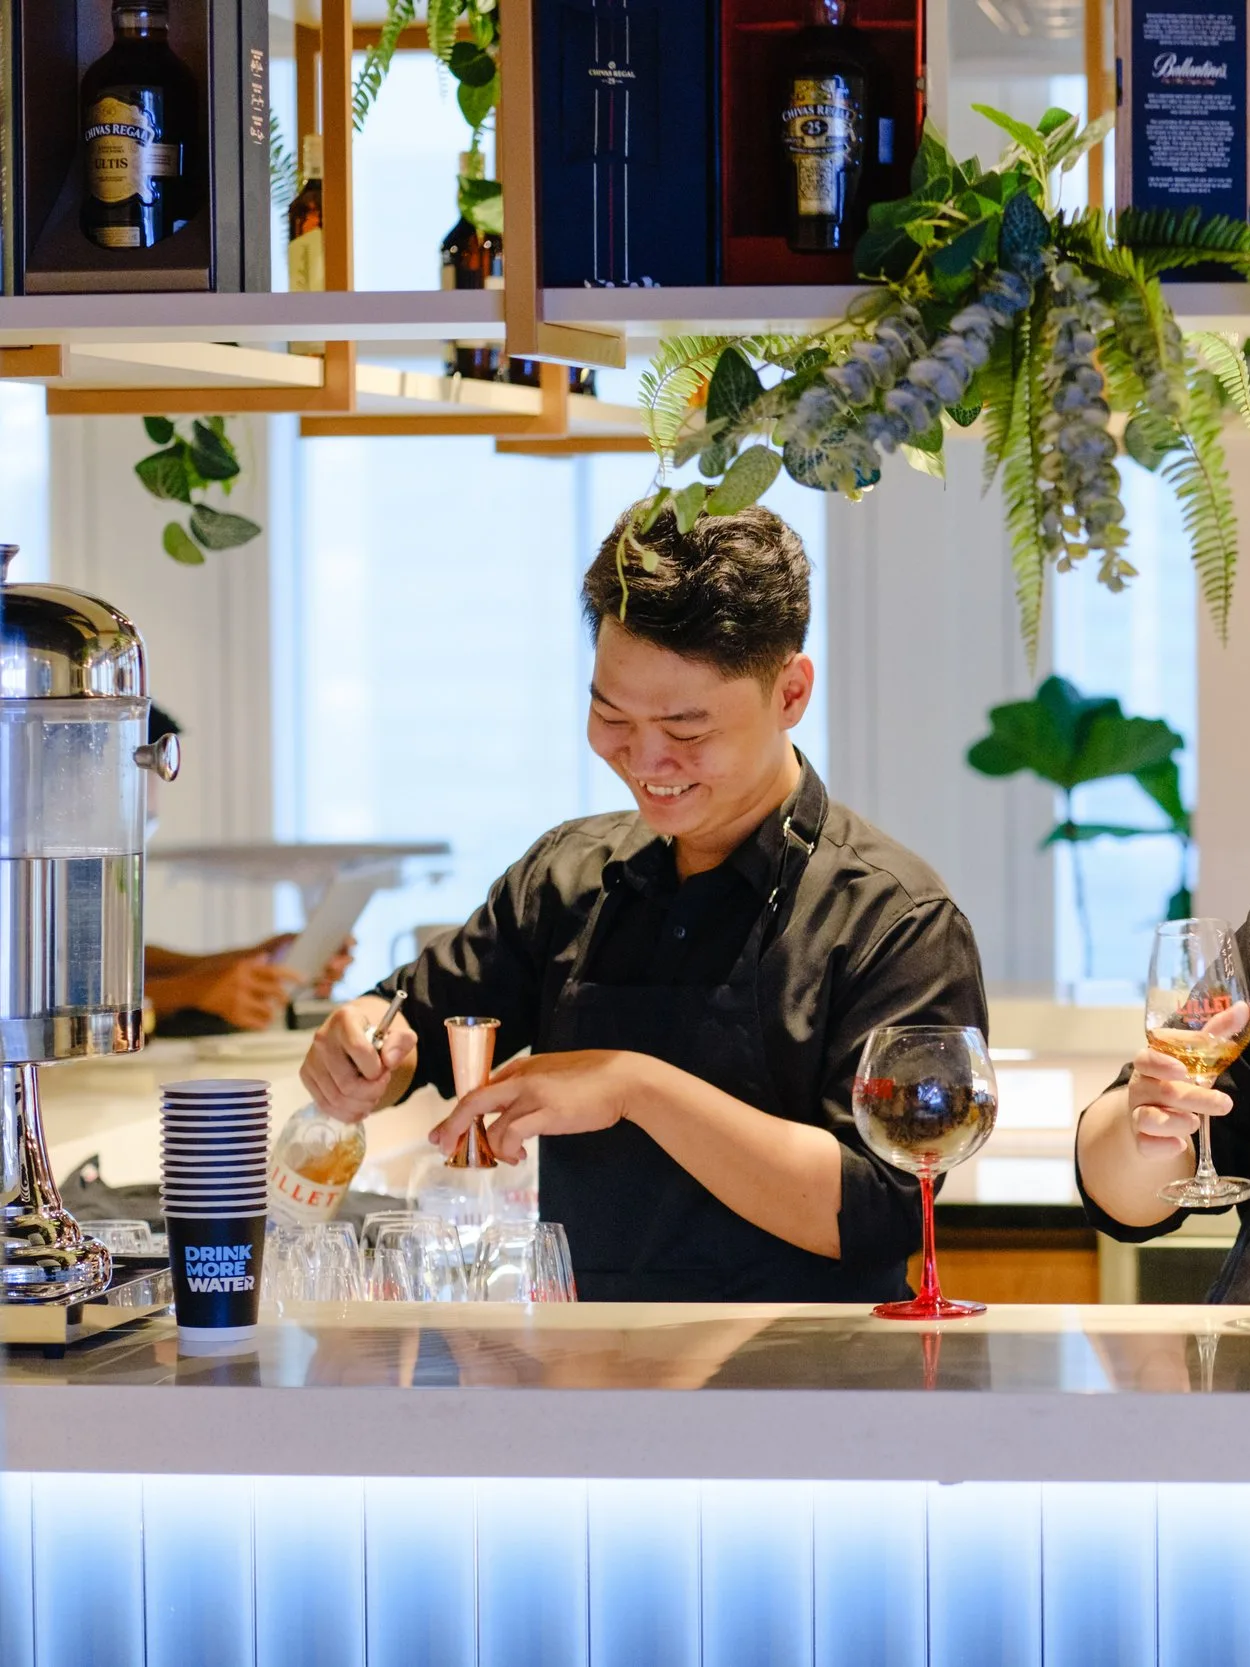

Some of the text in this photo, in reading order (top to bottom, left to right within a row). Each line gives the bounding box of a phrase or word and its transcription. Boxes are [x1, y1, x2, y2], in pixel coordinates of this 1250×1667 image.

[782, 106, 814, 122] CHIVAS
[85, 123, 148, 141] CHIVAS REGAL
[807, 121, 820, 134] 25
[95, 158, 128, 169] ULTIS
[271, 1166, 340, 1208] ILLET
[184, 1244, 253, 1262] DRINK
[185, 1260, 246, 1277] MORE
[187, 1275, 255, 1293] WATER
